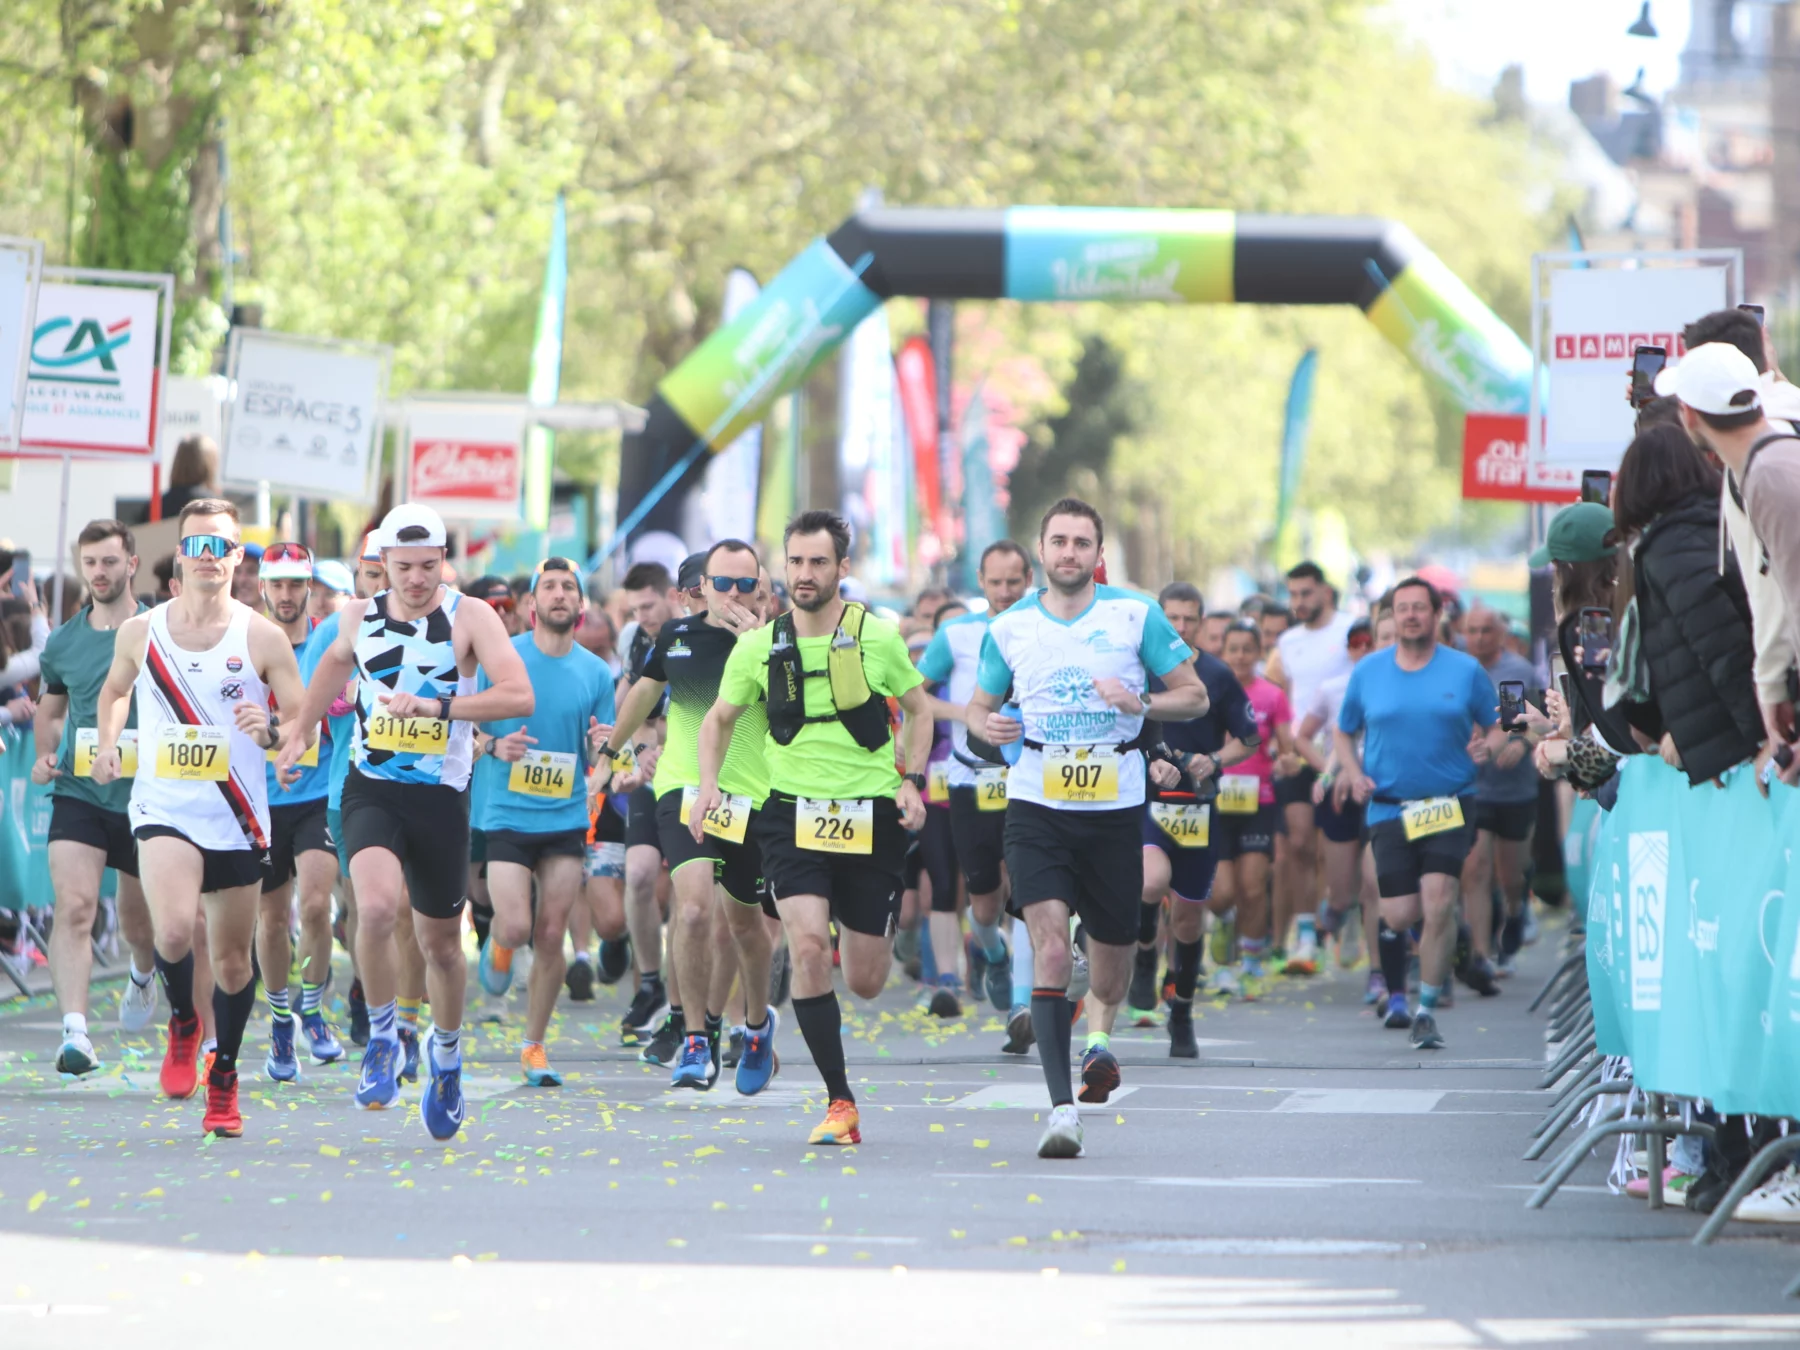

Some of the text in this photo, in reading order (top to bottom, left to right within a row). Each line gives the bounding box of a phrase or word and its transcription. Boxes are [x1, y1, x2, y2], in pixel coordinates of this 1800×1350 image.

[243, 391, 341, 425] ESPACE
[375, 716, 443, 741] 3114-3
[1047, 709, 1117, 729] MARATHON
[1044, 729, 1071, 742] VERT
[167, 743, 218, 768] 1807
[523, 764, 564, 788] 1814
[1061, 764, 1102, 788] 907
[986, 781, 1007, 800] 28
[703, 807, 733, 829] 43
[1160, 817, 1199, 837] 2614
[1412, 802, 1454, 829] 2270
[814, 817, 854, 841] 226
[1636, 883, 1659, 962] BS
